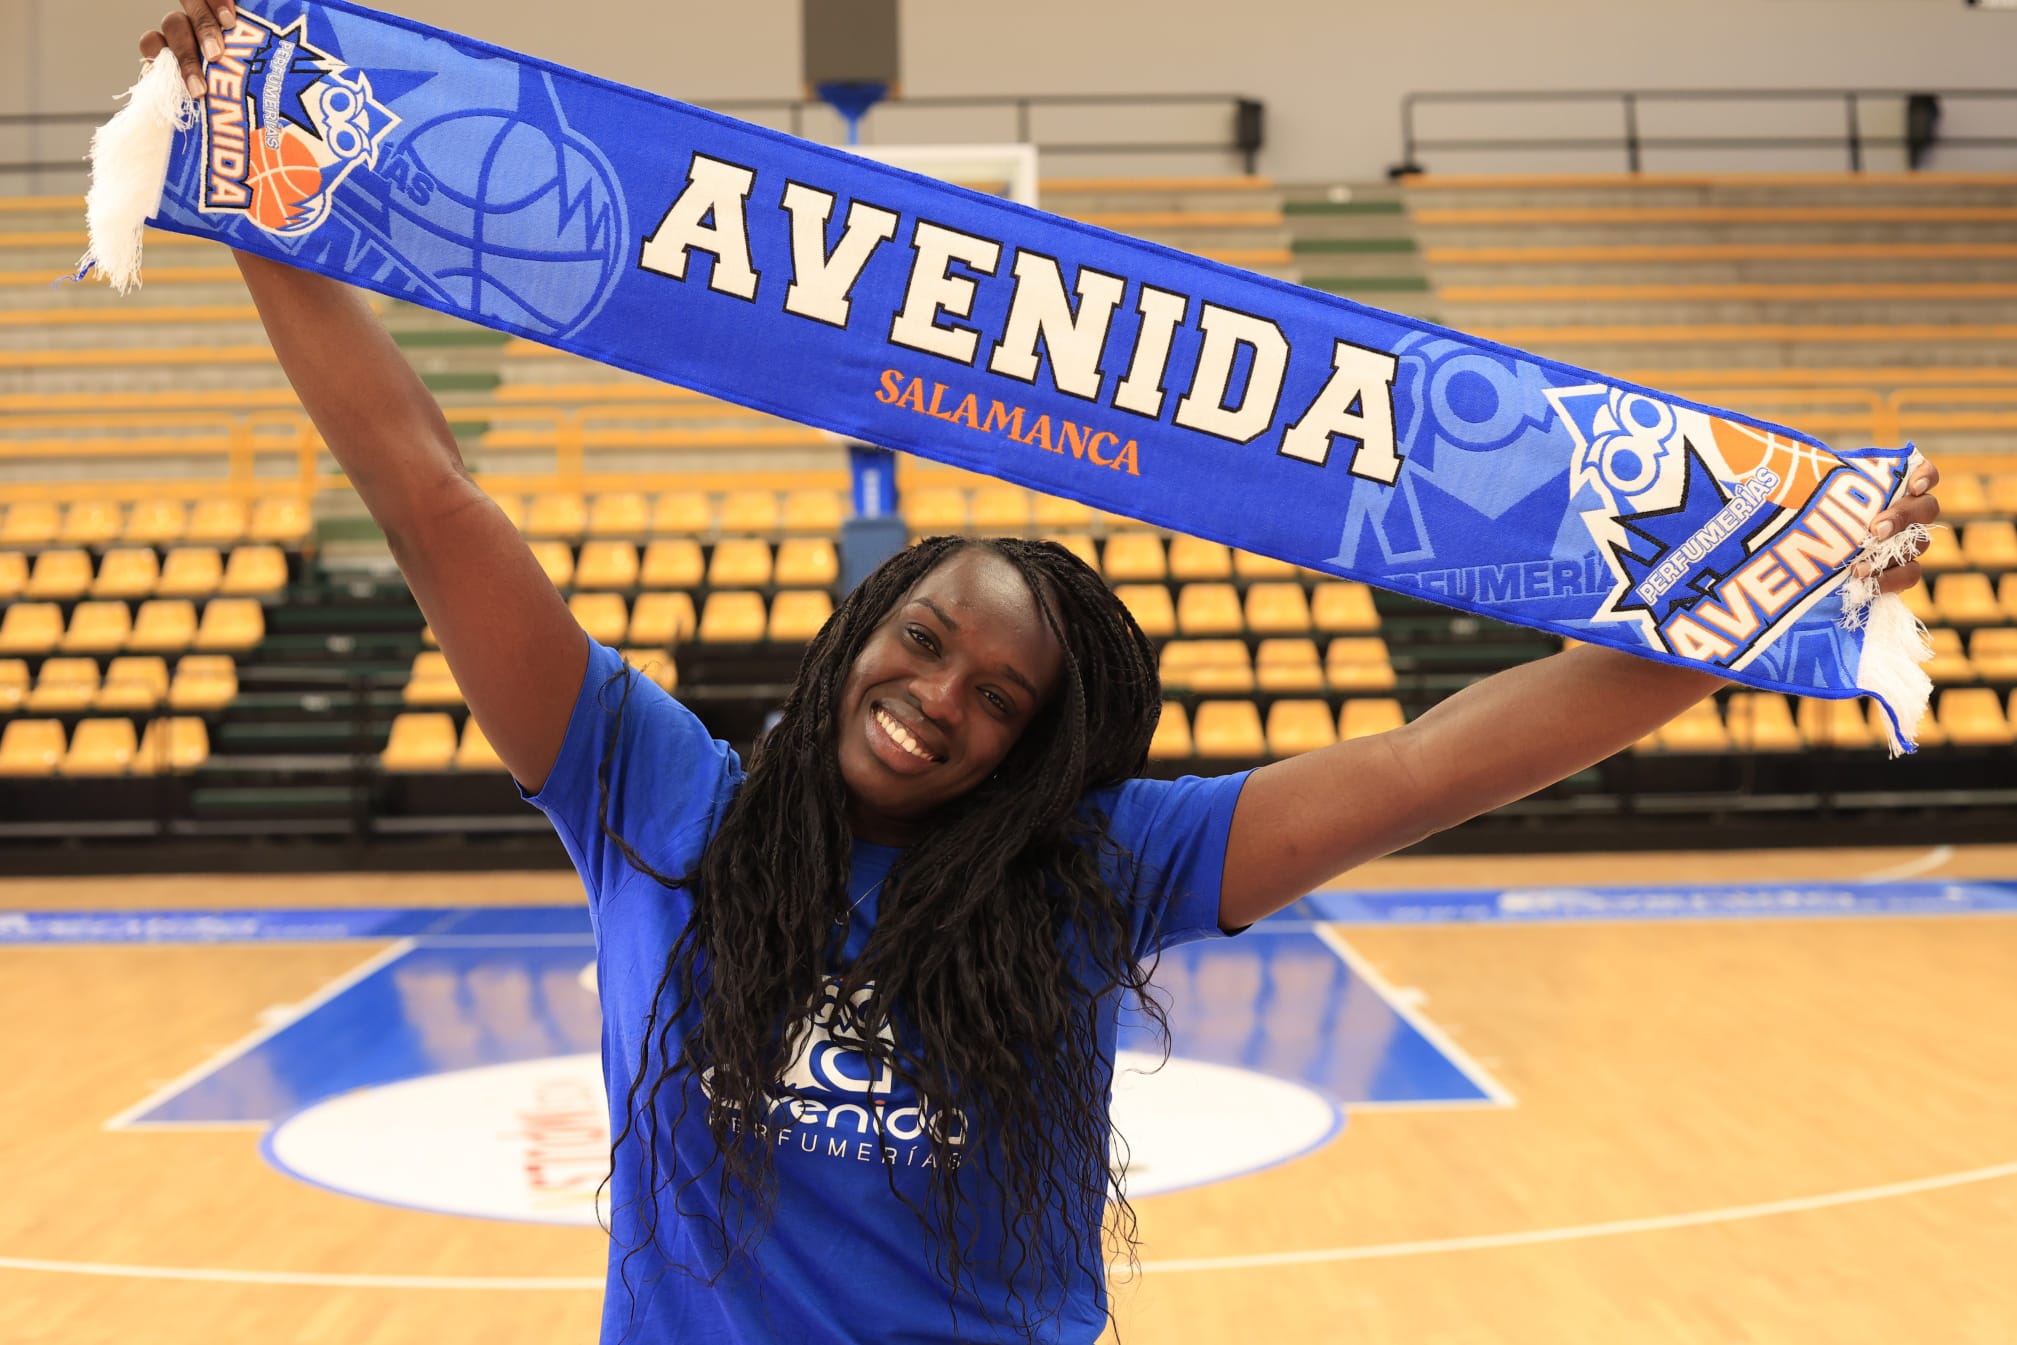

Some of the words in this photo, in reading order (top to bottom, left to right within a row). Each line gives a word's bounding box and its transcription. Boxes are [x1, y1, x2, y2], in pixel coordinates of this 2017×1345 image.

[207, 18, 267, 204] AVENIDA
[637, 150, 1404, 488] AVENIDA
[875, 368, 1141, 477] SALAMANCA
[1636, 466, 1780, 605] PERFUMERÍAS
[1664, 456, 1901, 662] AVENIDA
